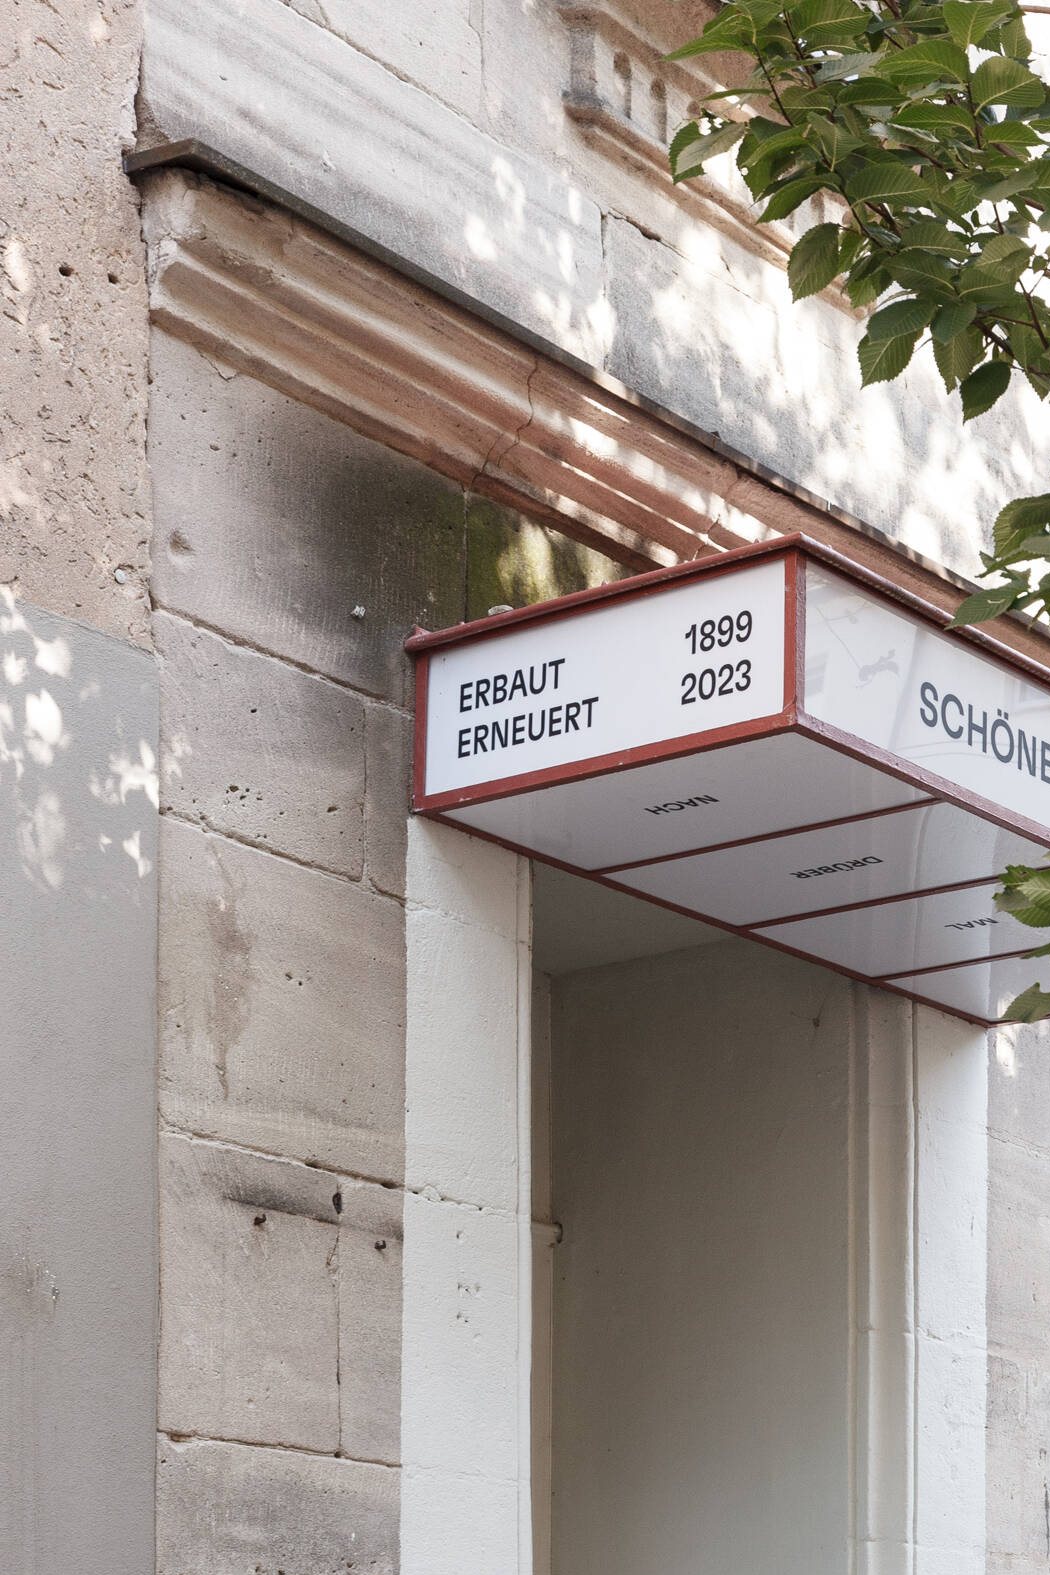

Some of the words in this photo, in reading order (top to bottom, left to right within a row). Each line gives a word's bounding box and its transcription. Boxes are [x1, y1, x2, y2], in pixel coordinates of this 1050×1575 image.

[459, 657, 566, 713] ERBAUT
[684, 610, 753, 655] 1899
[457, 696, 599, 759] ERNEUERT
[681, 659, 752, 706] 2023
[644, 794, 720, 815] NACH
[790, 855, 884, 880] DRÜBER
[944, 917, 999, 931] MAL
